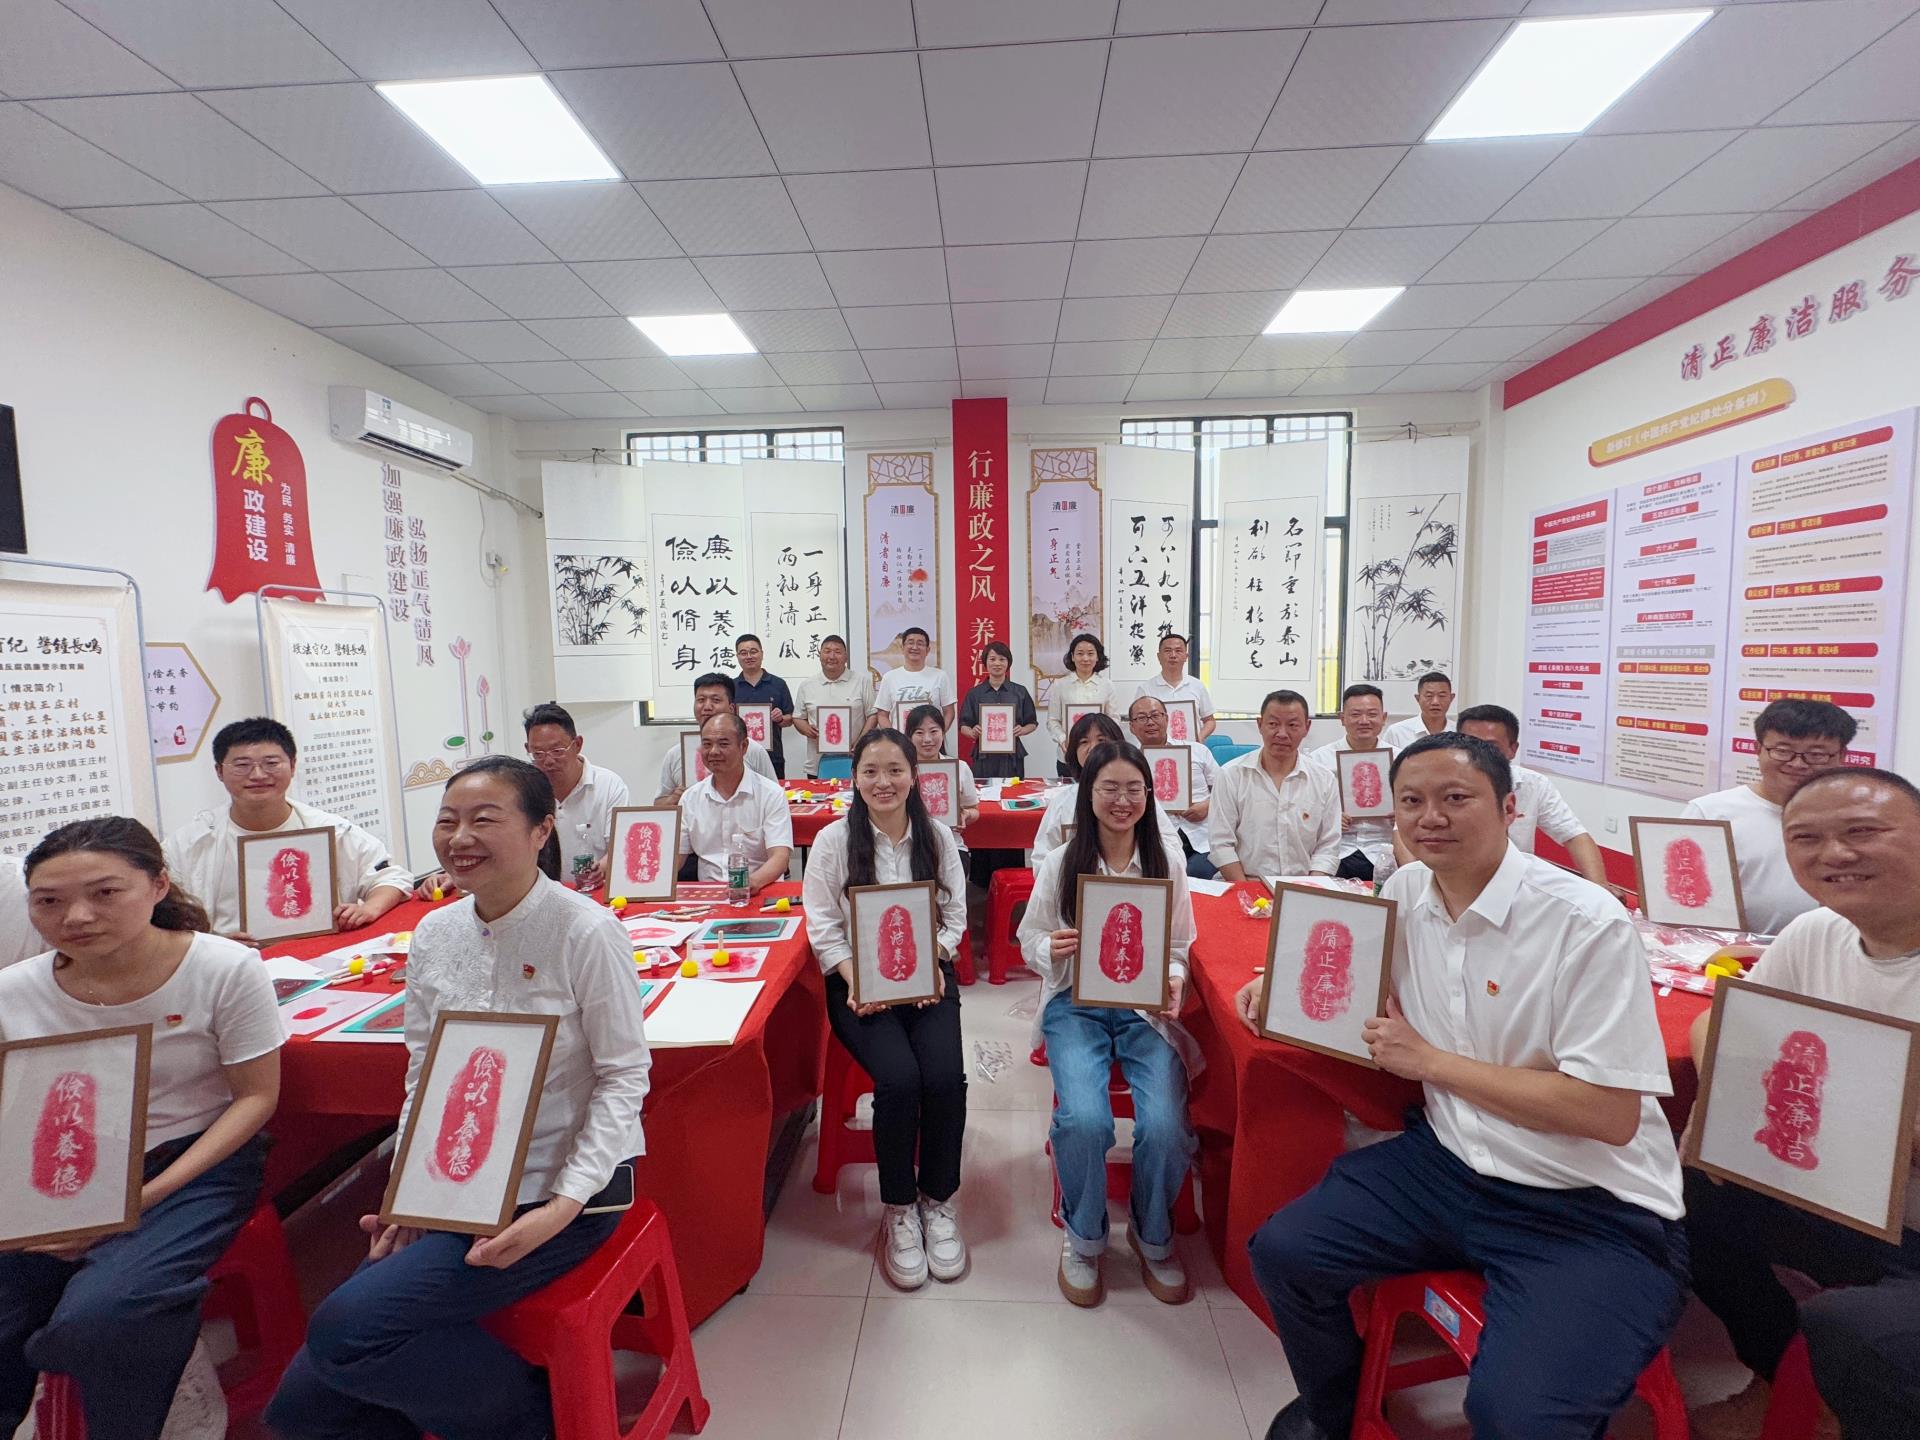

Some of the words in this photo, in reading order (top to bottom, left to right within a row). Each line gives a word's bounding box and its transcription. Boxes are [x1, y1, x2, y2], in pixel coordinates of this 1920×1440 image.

[1680, 254, 1920, 380] 清正廉洁服务
[231, 428, 272, 485] 廉
[281, 482, 292, 507] 为民
[243, 489, 269, 563] 政建设
[283, 512, 294, 536] 务实
[384, 462, 410, 622] 加强廉政建设
[968, 450, 996, 602] 行廉政之风
[285, 542, 296, 566] 清廉
[409, 516, 434, 666] 弘扬正气清风
[148, 685, 176, 695] 朴素
[151, 702, 178, 713] 节约
